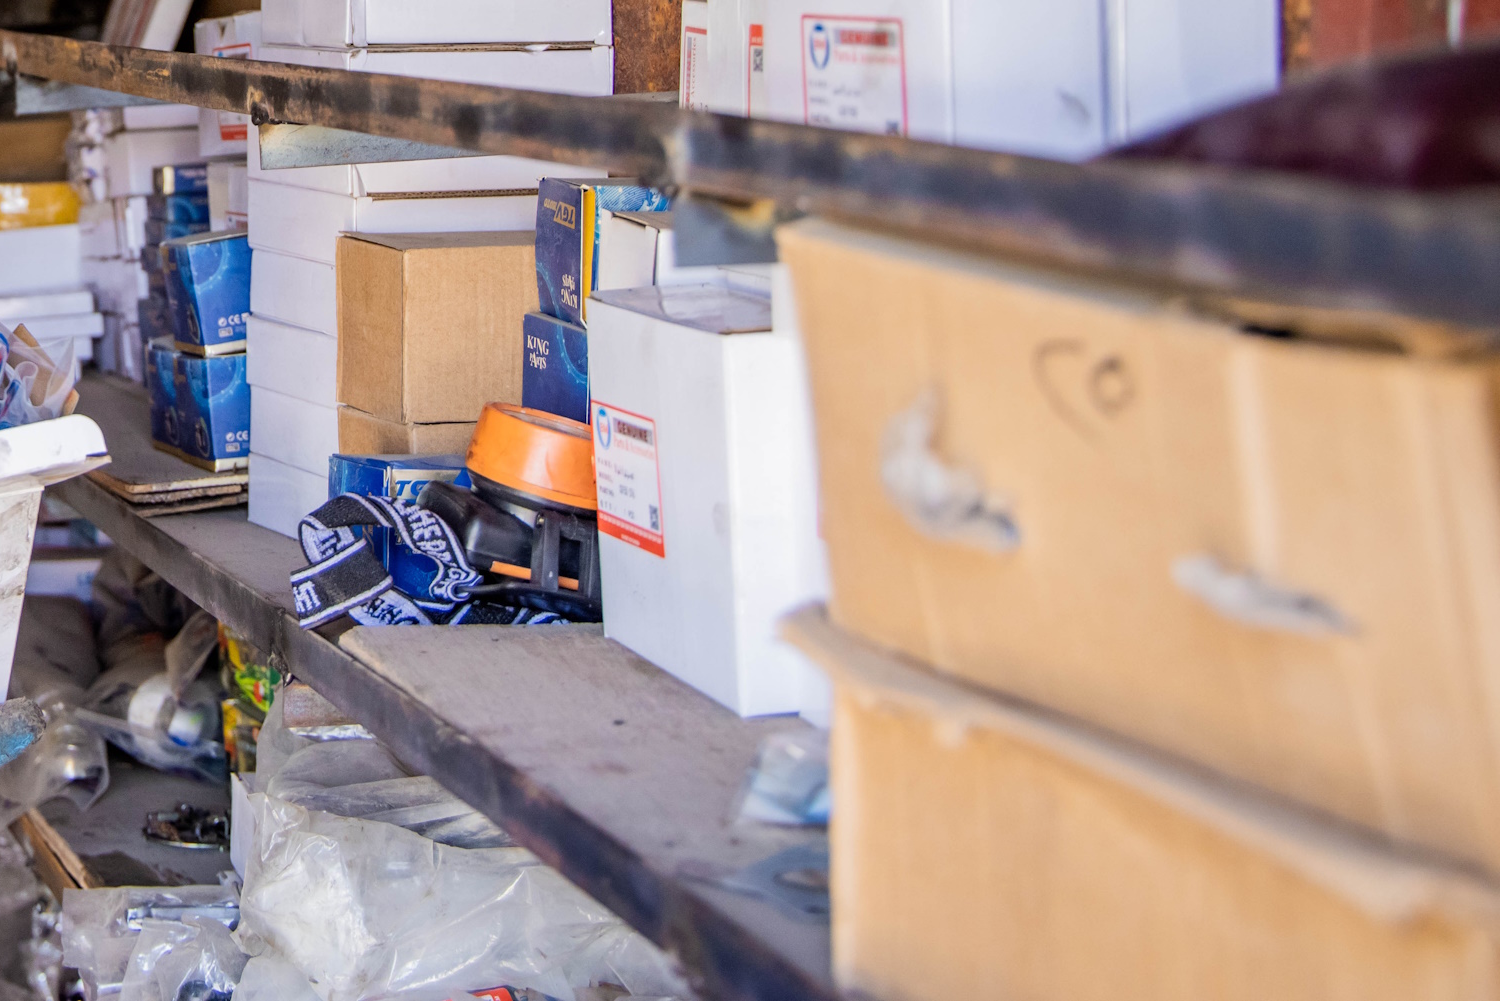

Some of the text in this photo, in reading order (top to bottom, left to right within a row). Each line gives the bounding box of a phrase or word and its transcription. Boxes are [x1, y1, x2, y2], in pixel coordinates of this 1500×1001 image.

[555, 204, 574, 225] TGV
[561, 288, 578, 309] KING
[527, 334, 550, 355] KING
[617, 420, 648, 443] GENUINE
